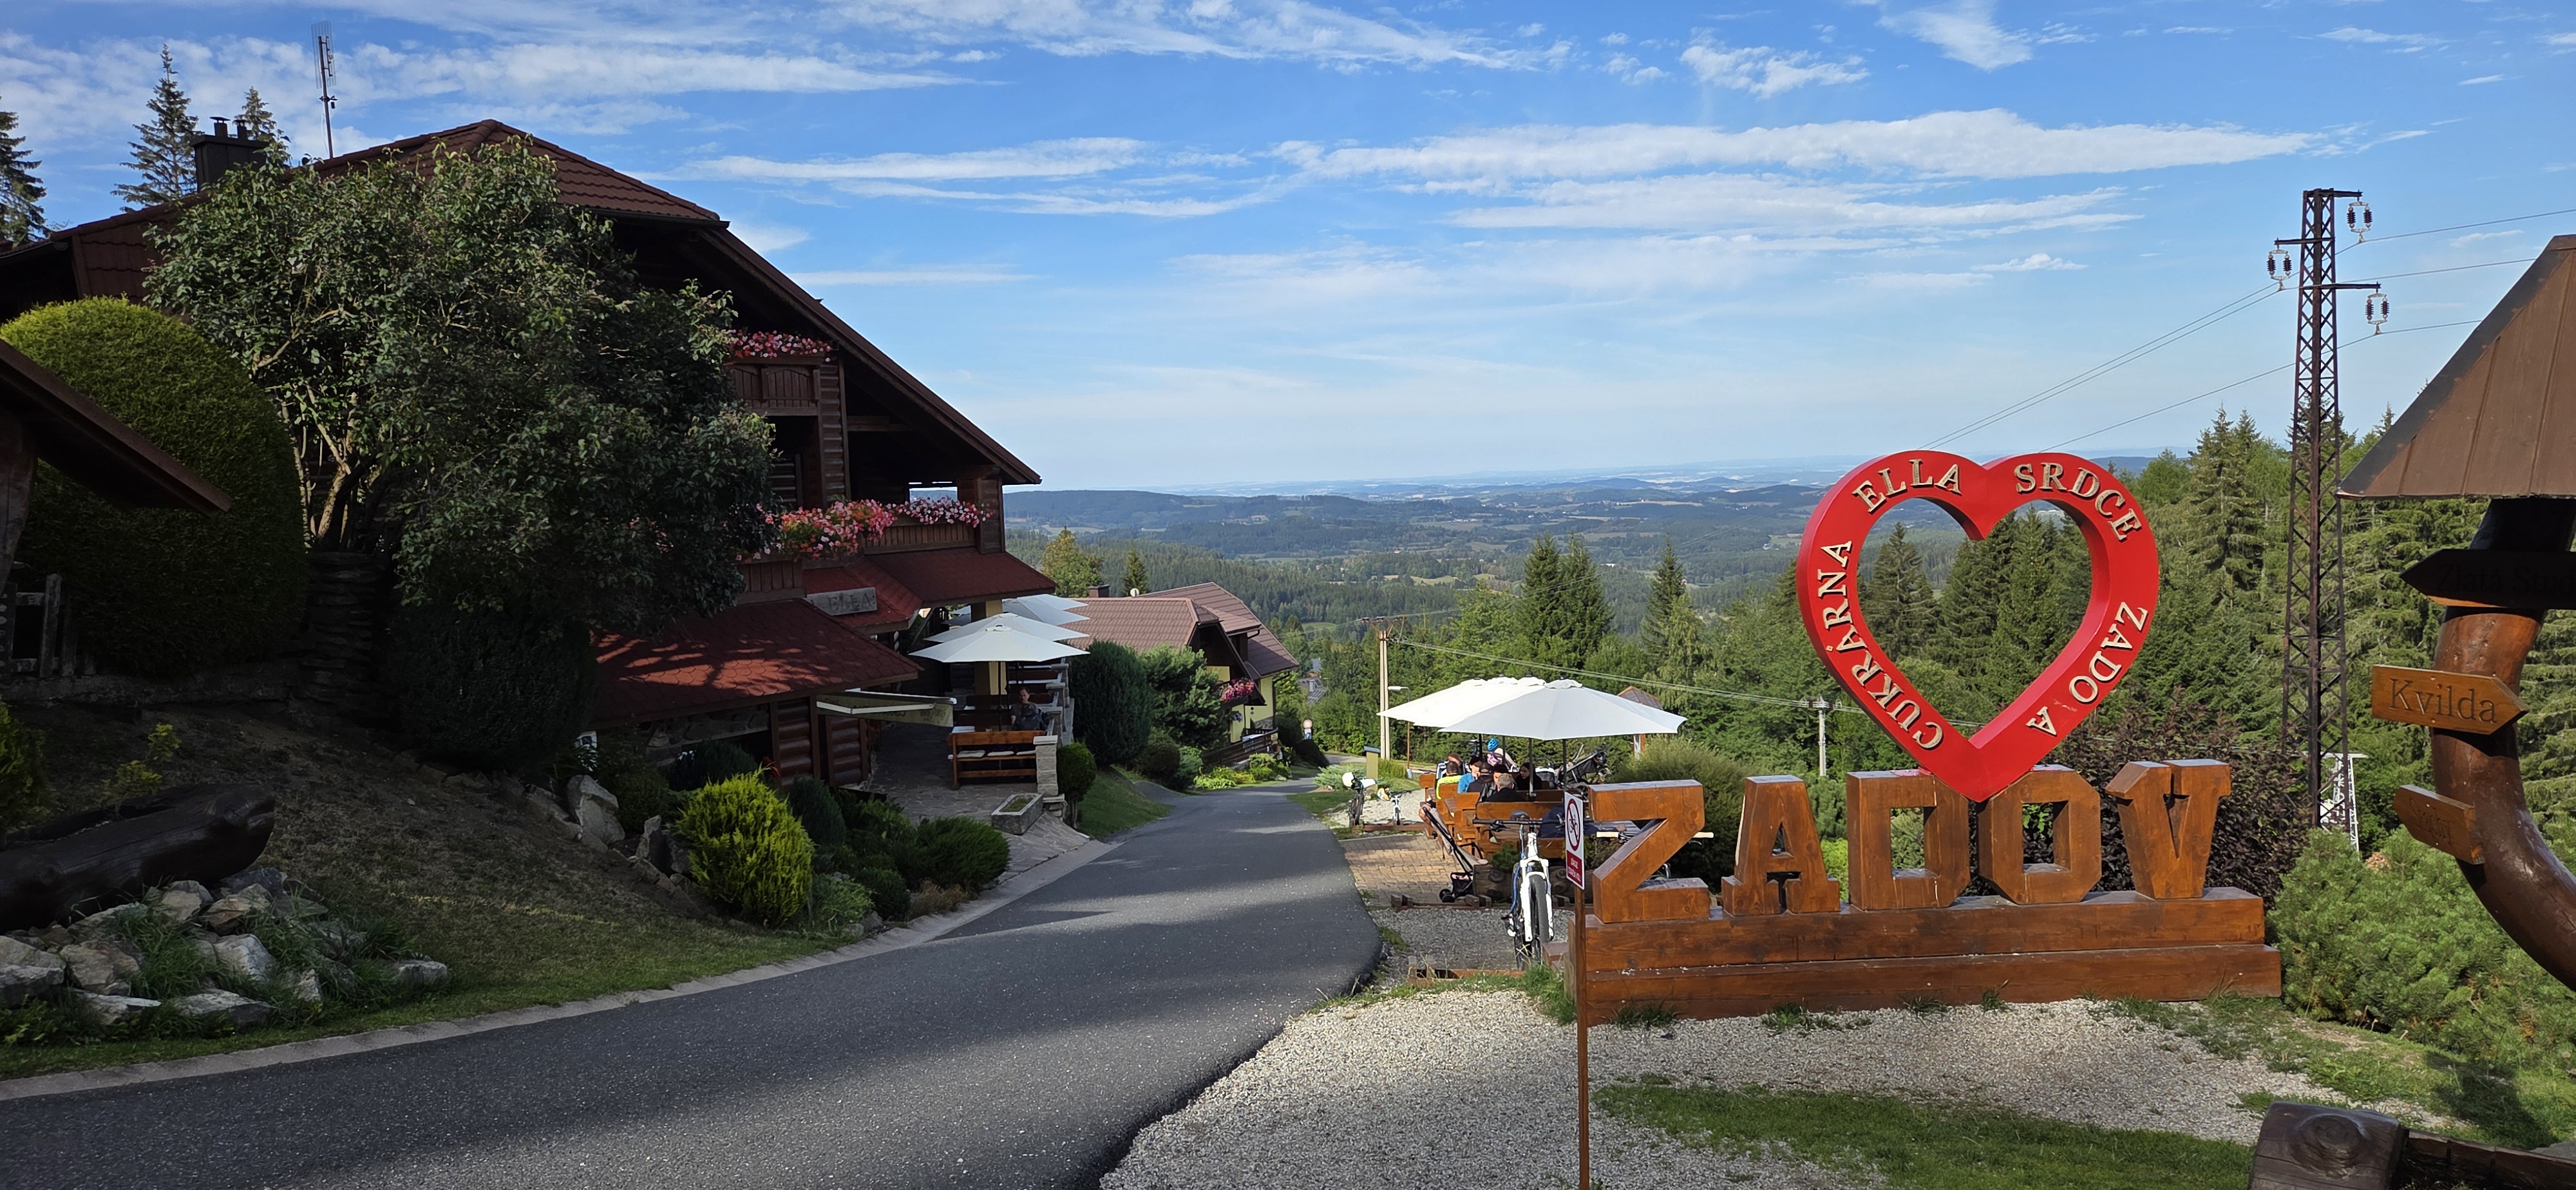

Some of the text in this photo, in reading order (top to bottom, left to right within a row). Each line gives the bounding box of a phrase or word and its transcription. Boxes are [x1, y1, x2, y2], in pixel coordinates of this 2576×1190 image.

[1852, 458, 1962, 515] ELLA
[2014, 462, 2141, 541] SRDCE
[1817, 541, 1944, 750] CUKRÁRNA
[2389, 679, 2497, 723] Kvilda
[1588, 759, 2231, 923] ZADOV
